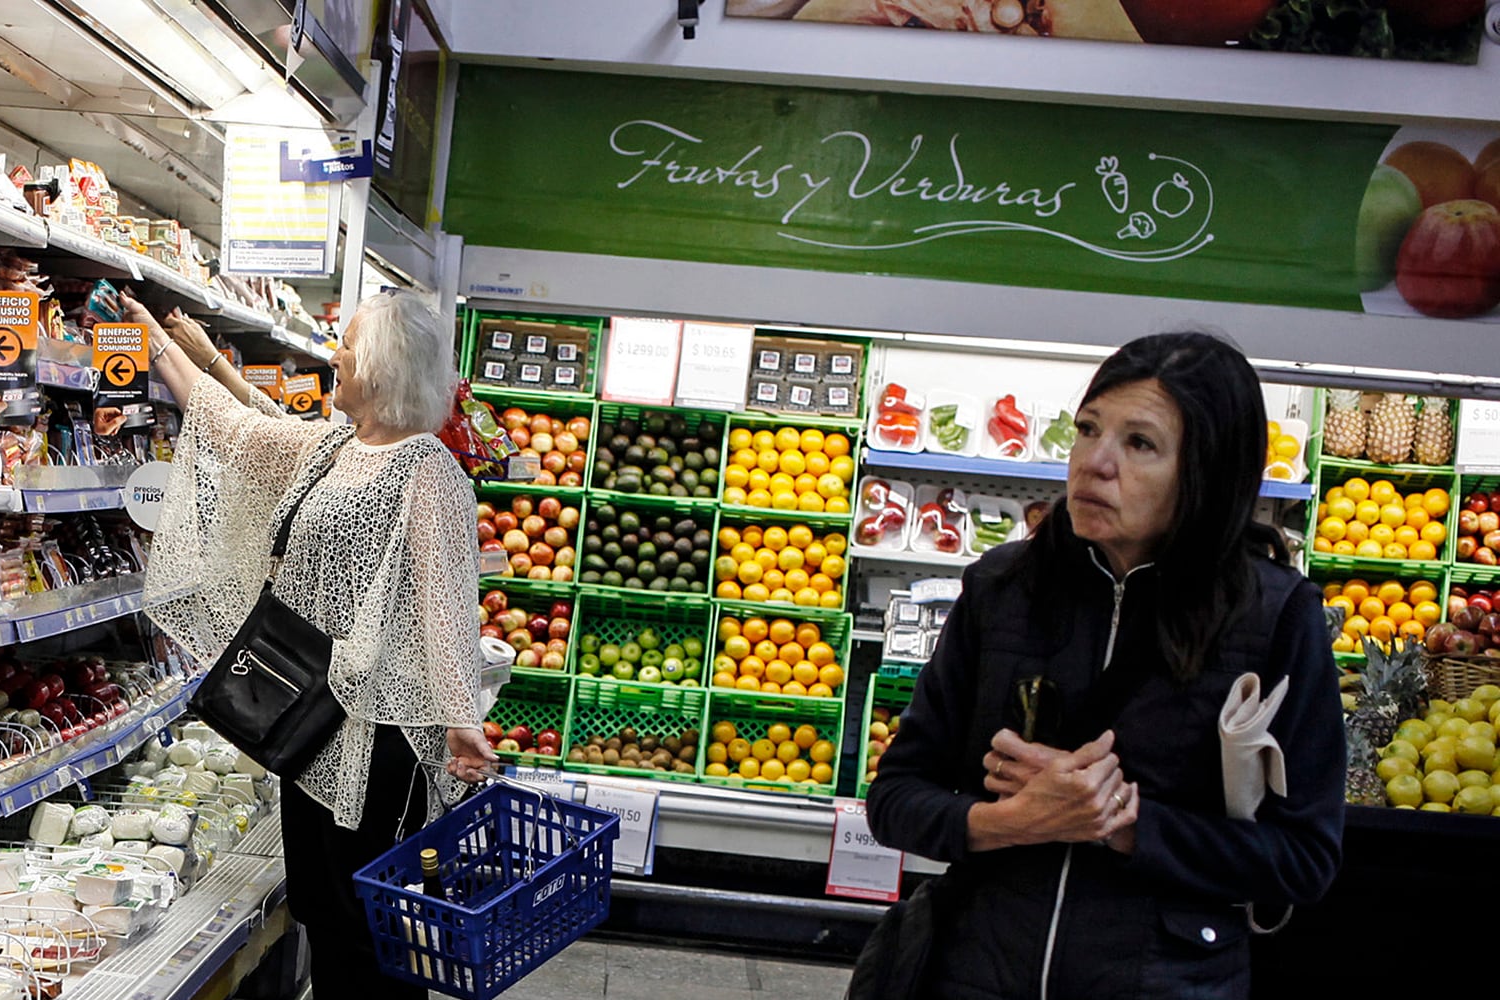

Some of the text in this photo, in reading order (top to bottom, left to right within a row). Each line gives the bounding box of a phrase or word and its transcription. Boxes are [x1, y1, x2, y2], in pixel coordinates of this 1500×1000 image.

[610, 120, 1076, 224] Frutas y Verduras
[98, 328, 142, 336] BENEFICIO
[98, 336, 142, 344] EXCLUSIVO
[98, 344, 142, 352] COMUNIDAD
[692, 343, 700, 356] $
[1472, 407, 1480, 420] $
[134, 486, 161, 494] precios
[844, 831, 852, 844] $
[533, 874, 566, 907] COTO
